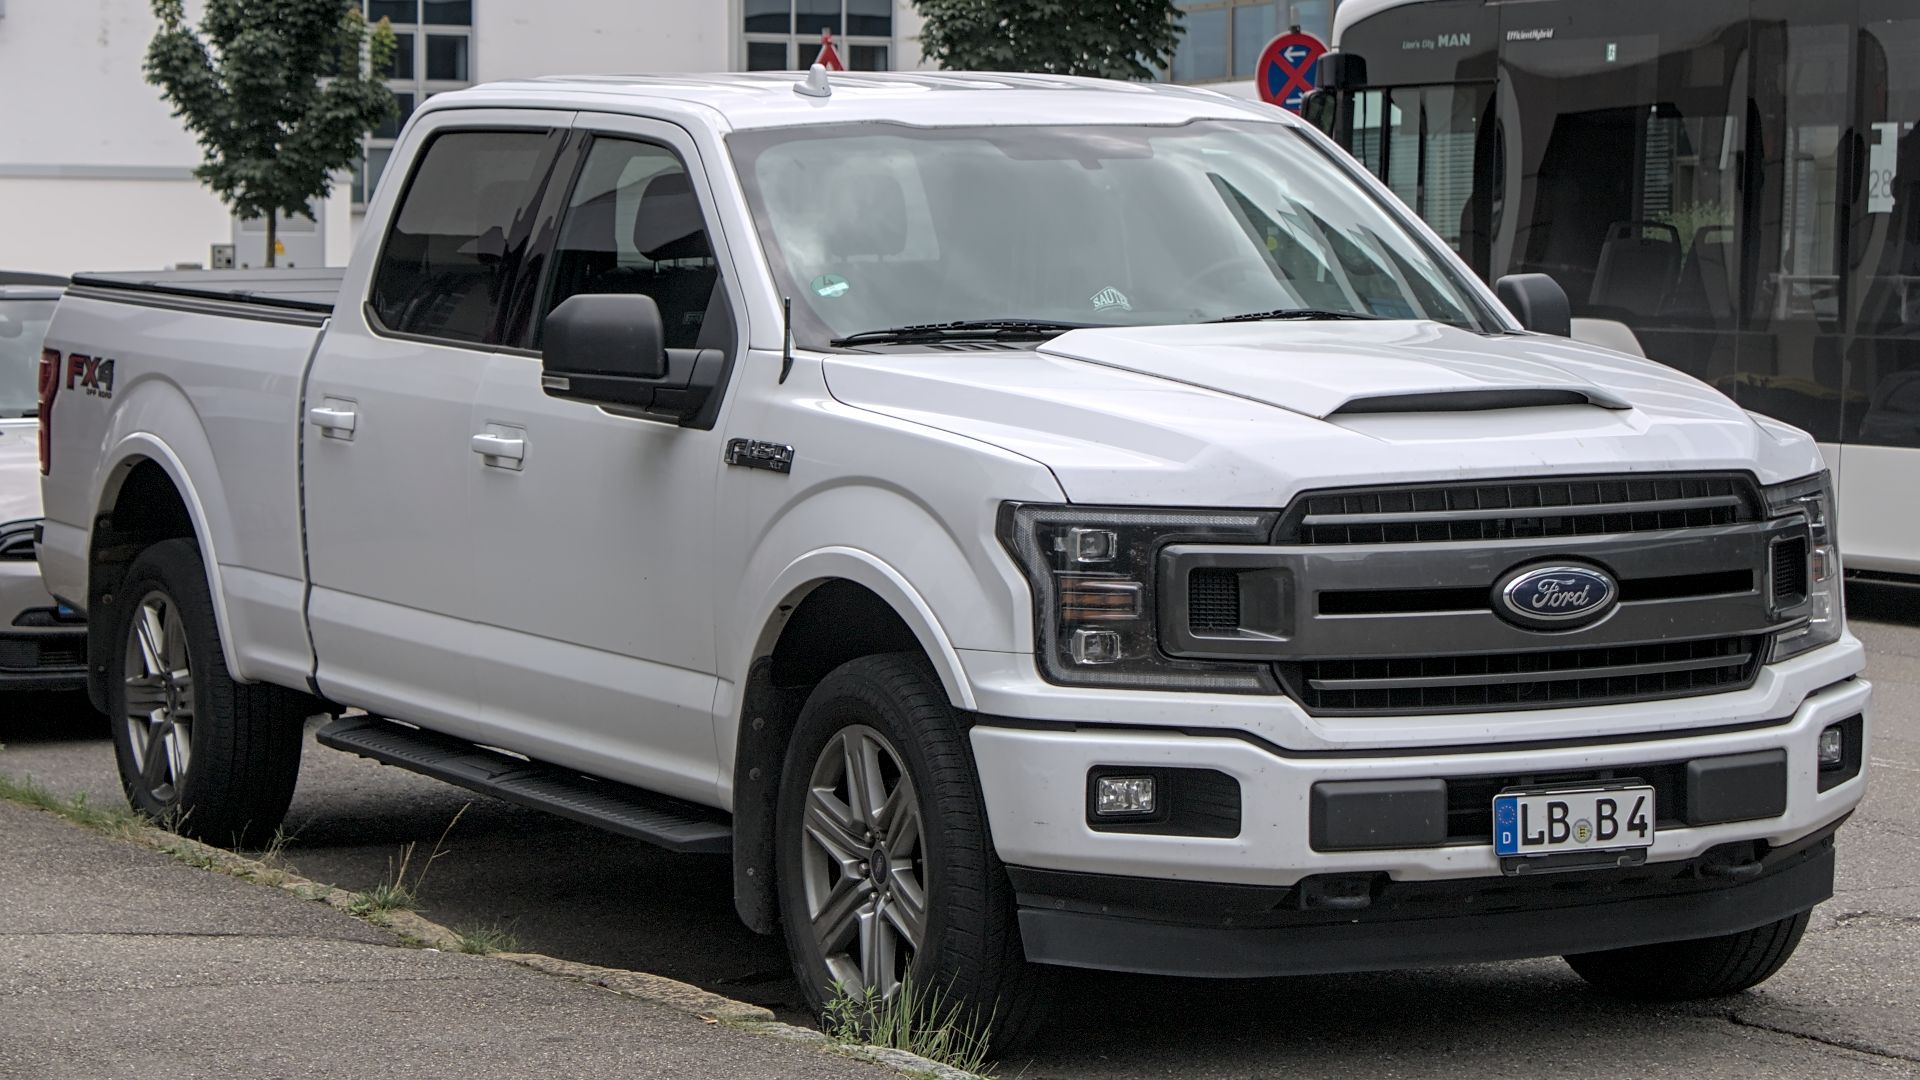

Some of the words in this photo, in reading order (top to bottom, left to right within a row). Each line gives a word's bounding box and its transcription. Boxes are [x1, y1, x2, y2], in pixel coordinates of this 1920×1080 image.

[1437, 33, 1471, 47] MAN
[1507, 28, 1554, 41] EfficientHybrid
[66, 352, 115, 391] FX4
[1532, 579, 1590, 608] Ford
[1521, 801, 1571, 846] LB
[1502, 832, 1511, 844] D
